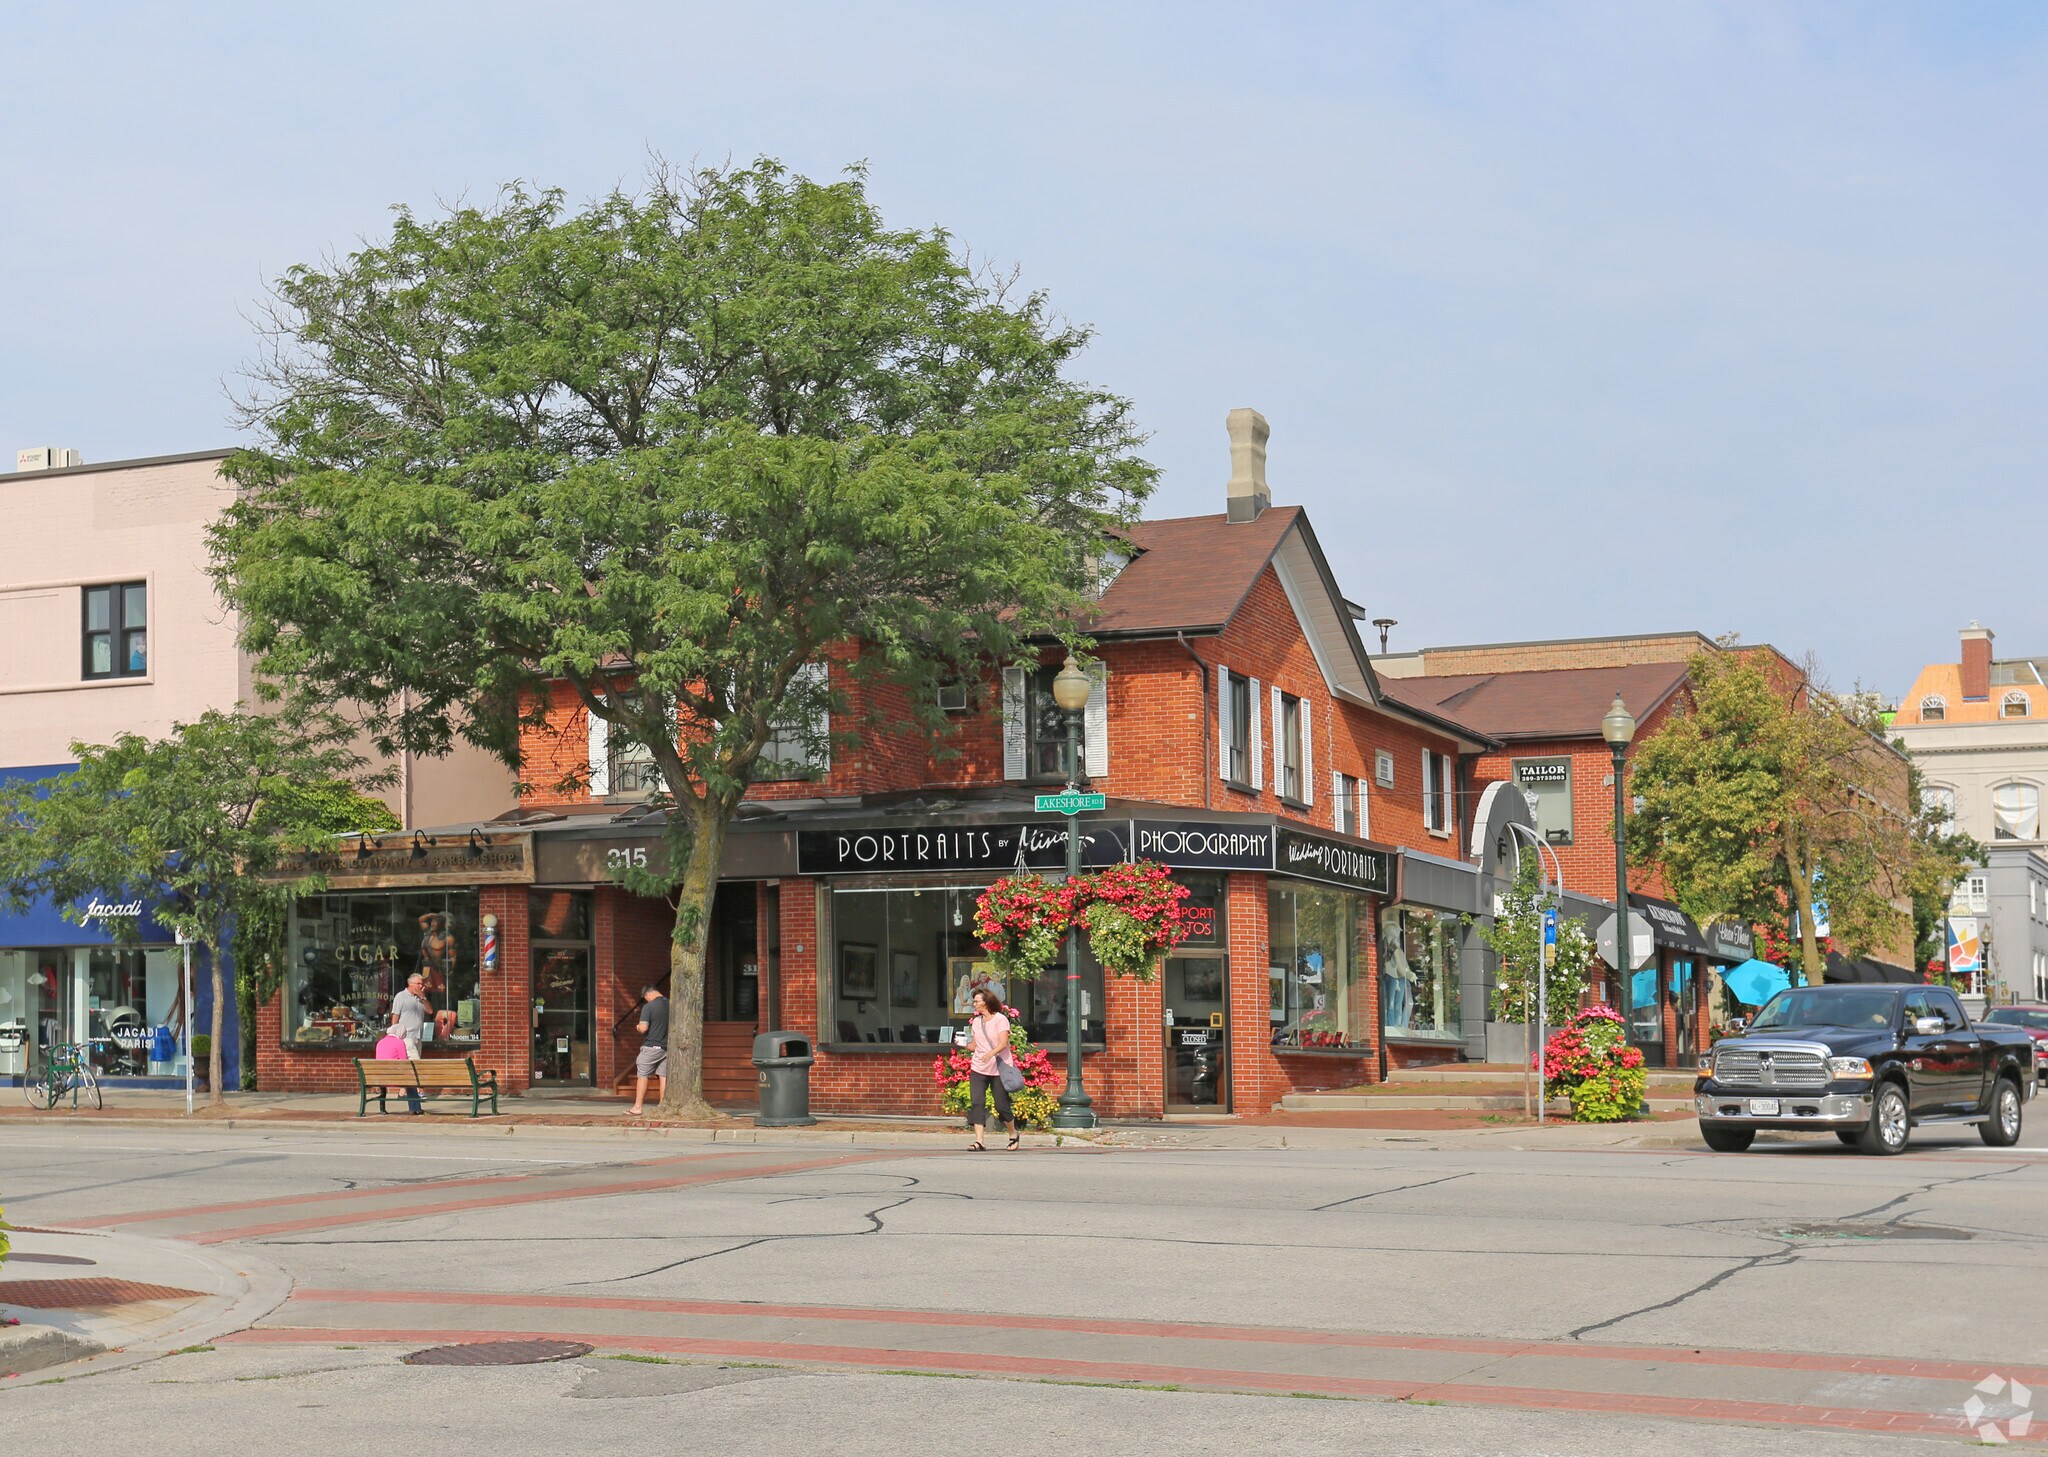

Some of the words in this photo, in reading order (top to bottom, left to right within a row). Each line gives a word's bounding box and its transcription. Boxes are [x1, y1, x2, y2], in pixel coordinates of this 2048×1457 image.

[1520, 765, 1566, 776] TAILOR
[1037, 797, 1091, 809] LAKESHORE
[838, 831, 991, 863] PORTRAITS
[998, 839, 1010, 848] BY
[1140, 830, 1268, 857] PHOTOGRAPHY
[1288, 842, 1324, 865] Wedding
[1324, 845, 1377, 881] PORTRAITS
[350, 925, 382, 934] VILLAGE
[335, 944, 399, 962] CIGAR
[340, 991, 395, 1003] BARBERSHOP
[117, 1027, 158, 1038] JACADI
[1182, 1035, 1207, 1044] CLOSED
